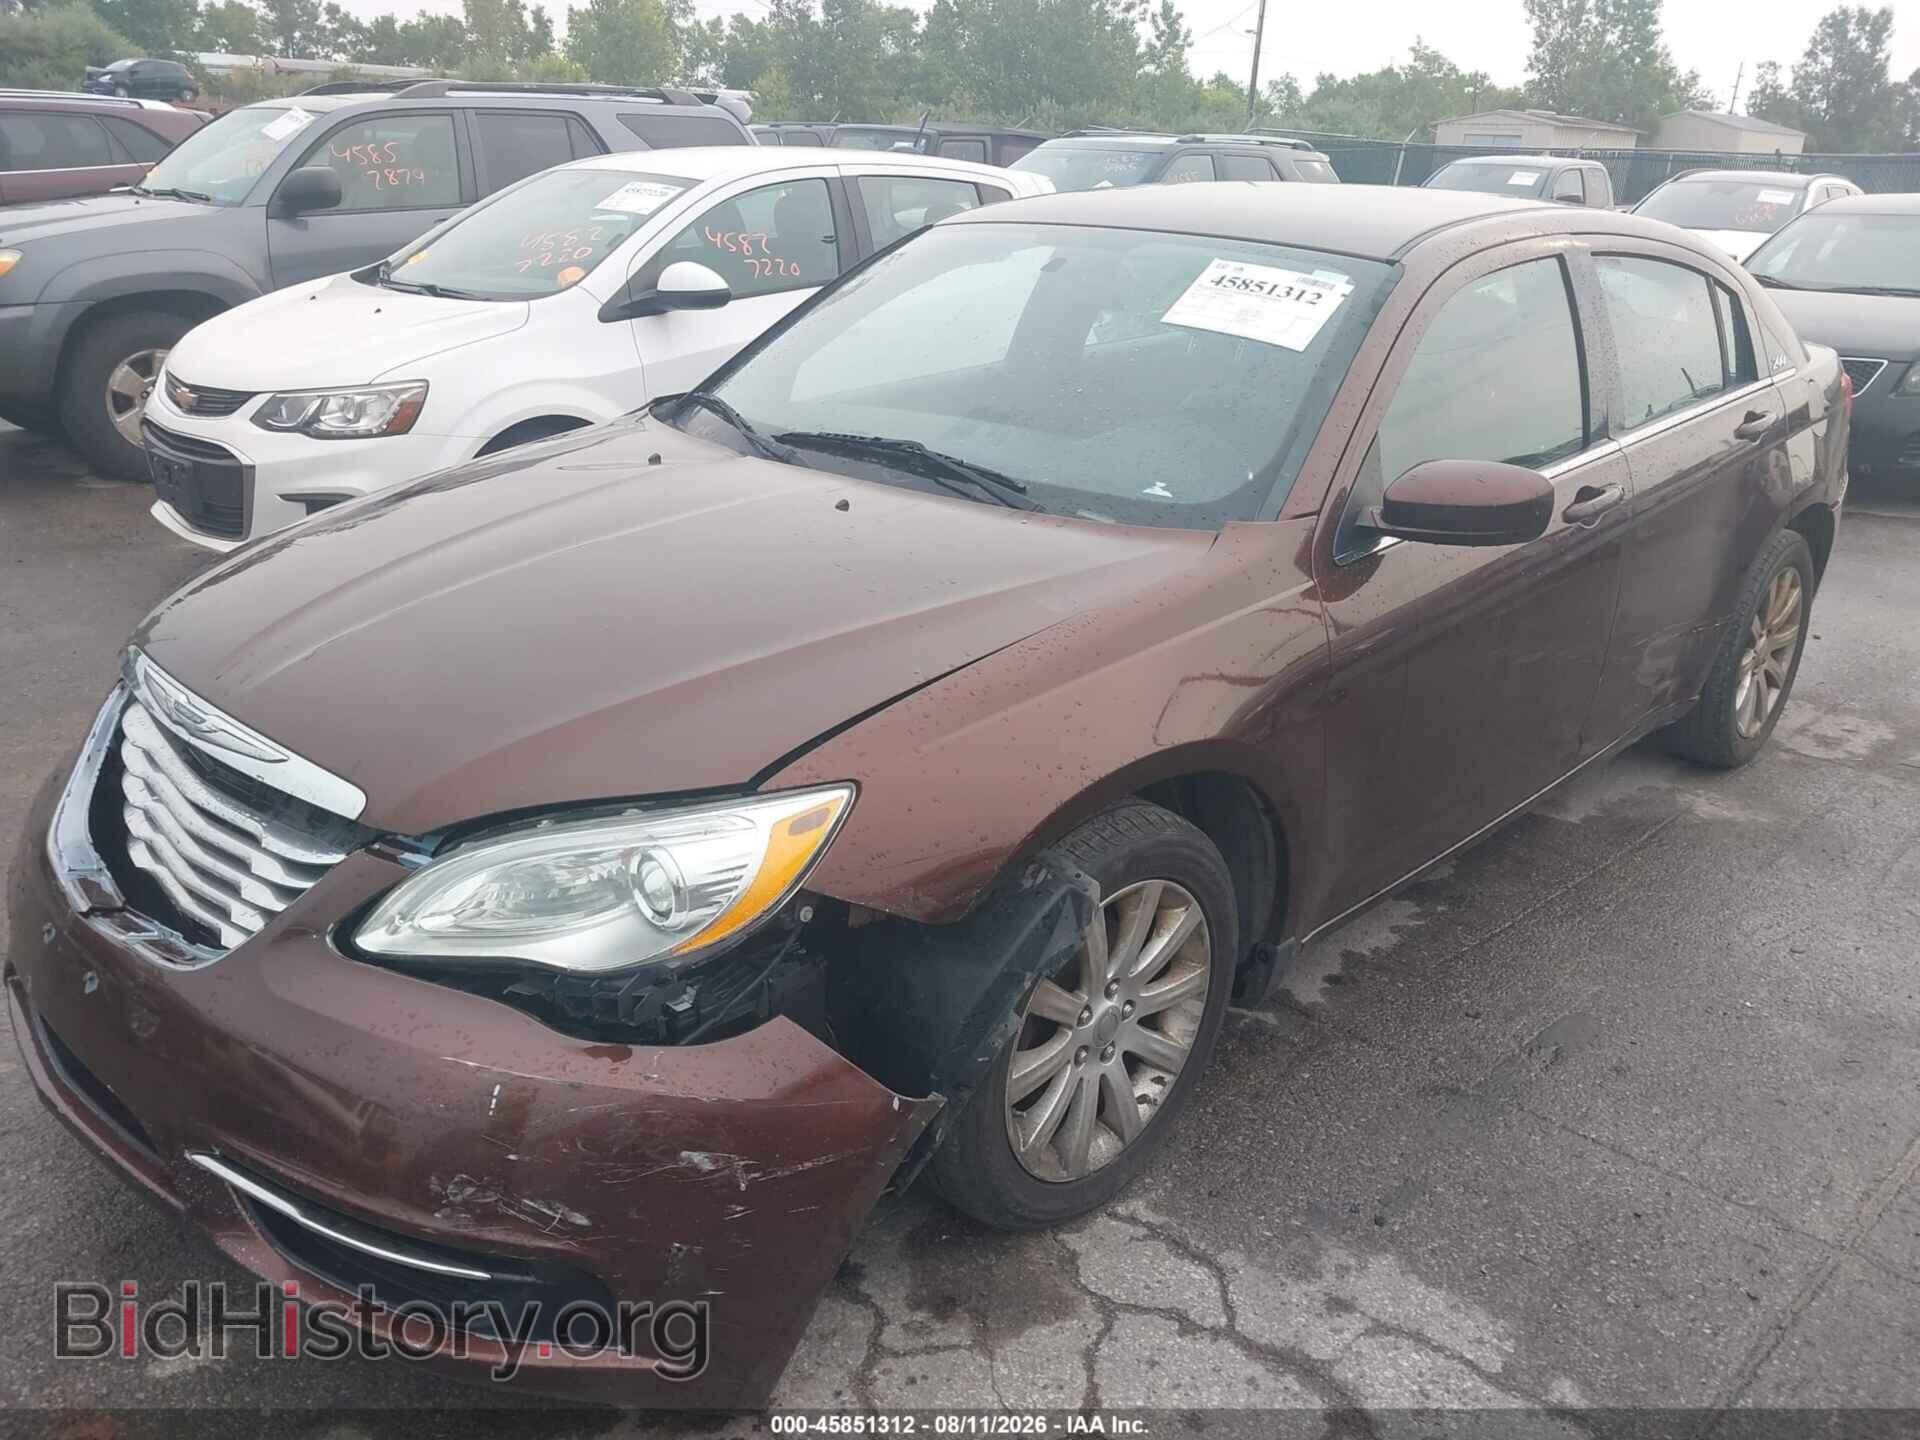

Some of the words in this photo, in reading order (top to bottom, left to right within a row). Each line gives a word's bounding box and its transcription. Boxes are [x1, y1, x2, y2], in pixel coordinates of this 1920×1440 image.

[328, 142, 400, 165] 4585
[743, 258, 800, 279] 7220
[1210, 274, 1323, 305] 45851312
